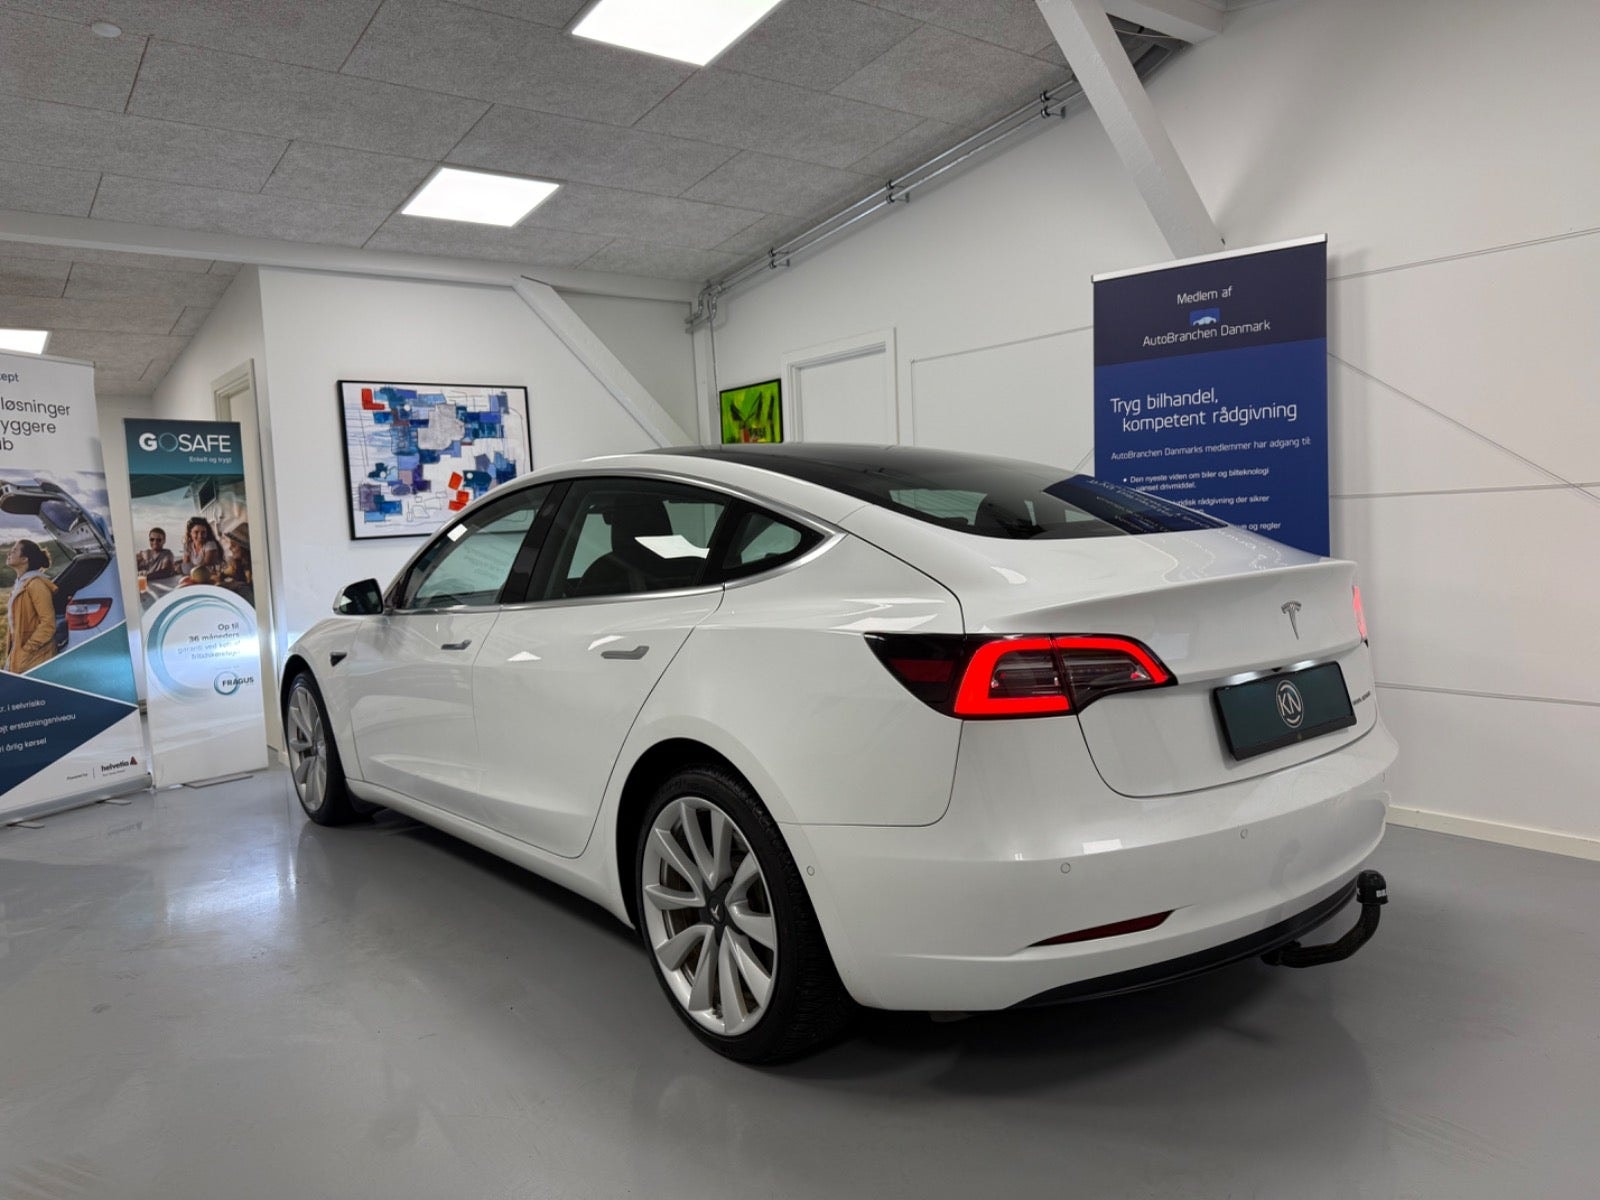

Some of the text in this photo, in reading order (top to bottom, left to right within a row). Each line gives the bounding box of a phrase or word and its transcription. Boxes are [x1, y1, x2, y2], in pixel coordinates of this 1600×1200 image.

[1177, 285, 1233, 304] Medlem af
[1143, 320, 1271, 347] AutoBranchen Danmark
[0, 372, 19, 384] ept
[1110, 387, 1219, 415] Tryg bilhandel,
[1123, 402, 1297, 432] kompetent rådgivning
[138, 432, 232, 453] GOSAFE
[1111, 449, 1162, 460] AutoBranchen
[1165, 445, 1203, 456] Danmarks
[1205, 442, 1251, 453] medlemmer
[1254, 440, 1266, 449] har
[1269, 438, 1299, 449] adgang
[1130, 476, 1144, 484] Den
[1218, 470, 1227, 478] og
[1249, 523, 1258, 531] og
[217, 622, 239, 632] Op til
[222, 676, 254, 687] FRAGUS
